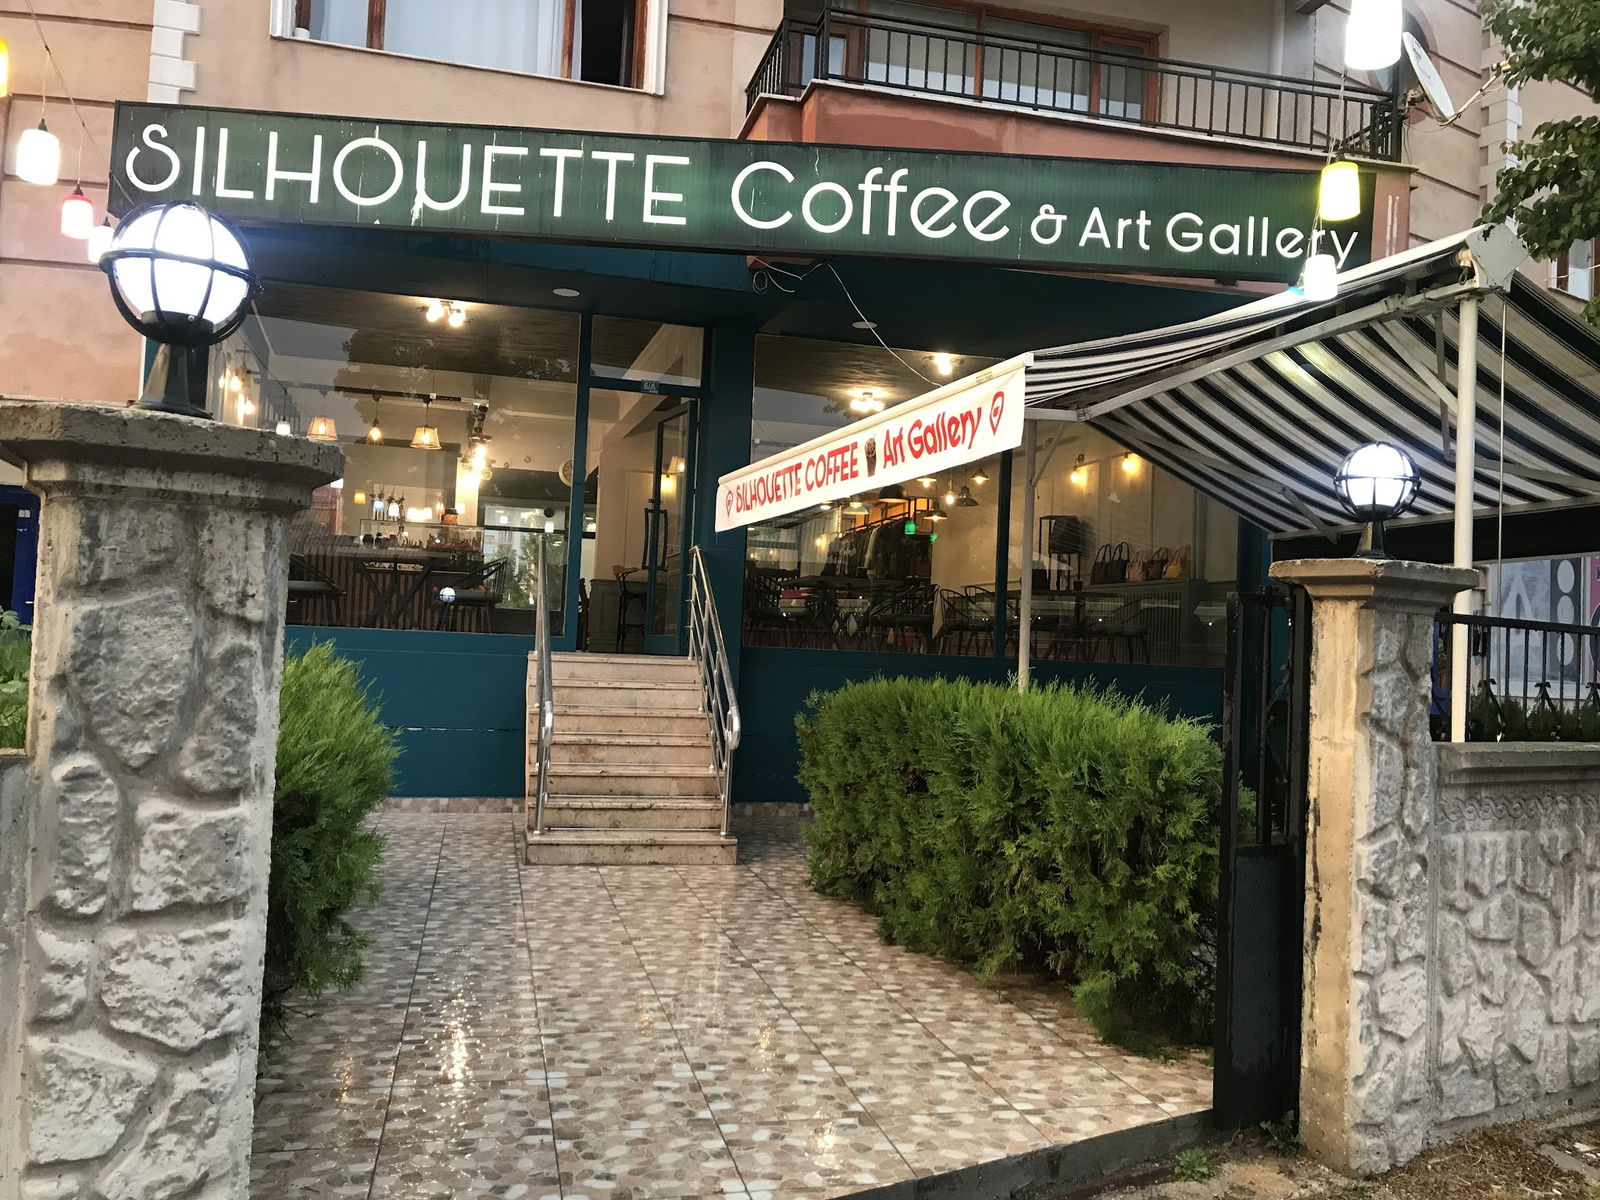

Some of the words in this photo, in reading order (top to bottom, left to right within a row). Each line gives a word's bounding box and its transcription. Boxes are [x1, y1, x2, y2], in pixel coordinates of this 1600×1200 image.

[125, 123, 690, 226] SILHOUETTE
[730, 160, 1011, 242] Coffee
[1030, 203, 1067, 246] &
[1079, 206, 1152, 251] Art
[1166, 211, 1359, 270] Gallery
[735, 462, 802, 513] SILHOUETTE
[805, 441, 858, 491] COFFEE
[883, 426, 905, 469] Art
[908, 406, 982, 459] Gallery
